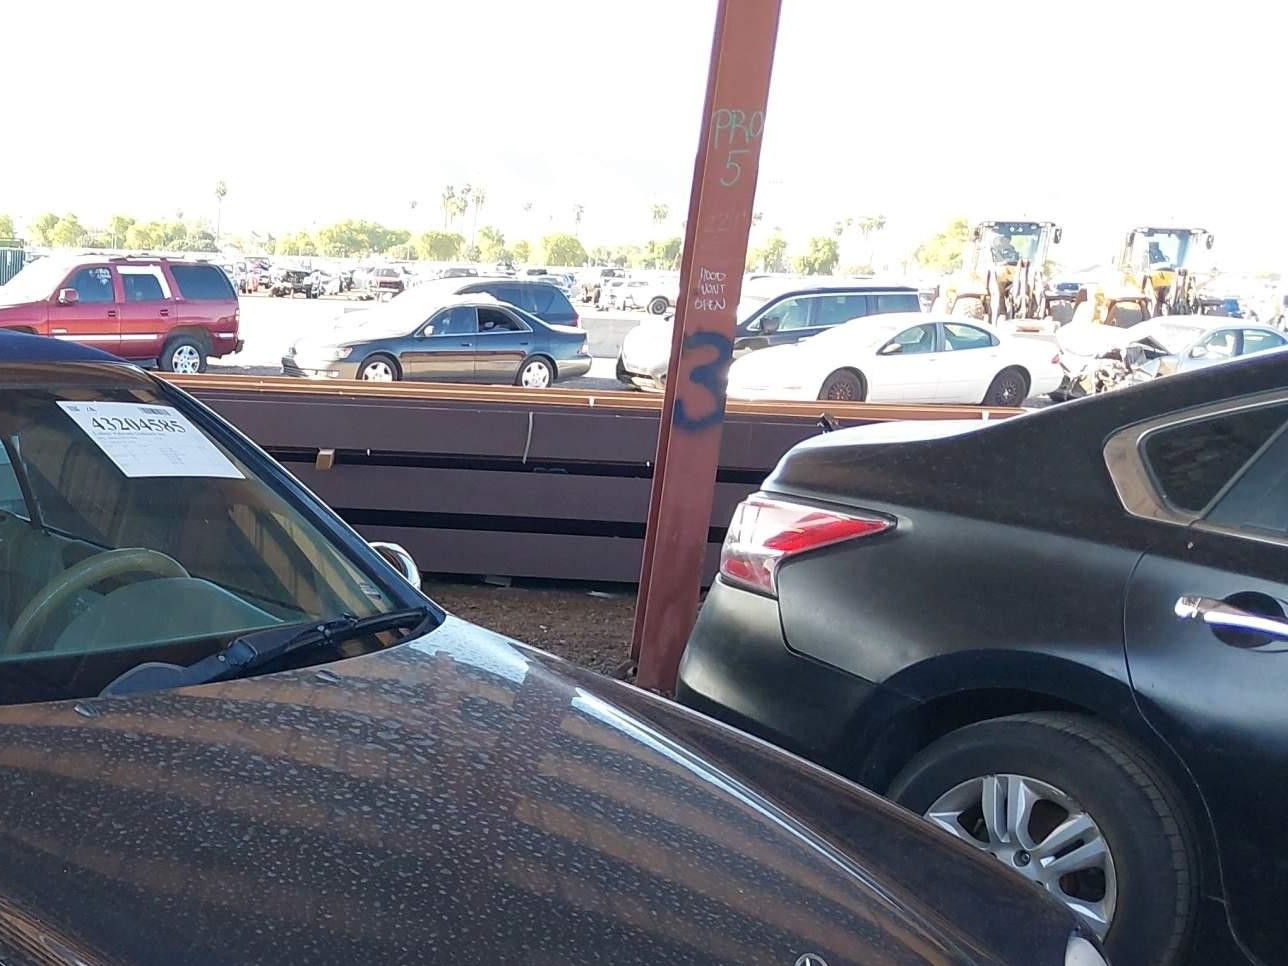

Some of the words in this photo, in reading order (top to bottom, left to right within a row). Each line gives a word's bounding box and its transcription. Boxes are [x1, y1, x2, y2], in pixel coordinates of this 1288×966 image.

[720, 149, 750, 187] 5
[675, 331, 733, 430] 3
[91, 416, 187, 433] 43204585
